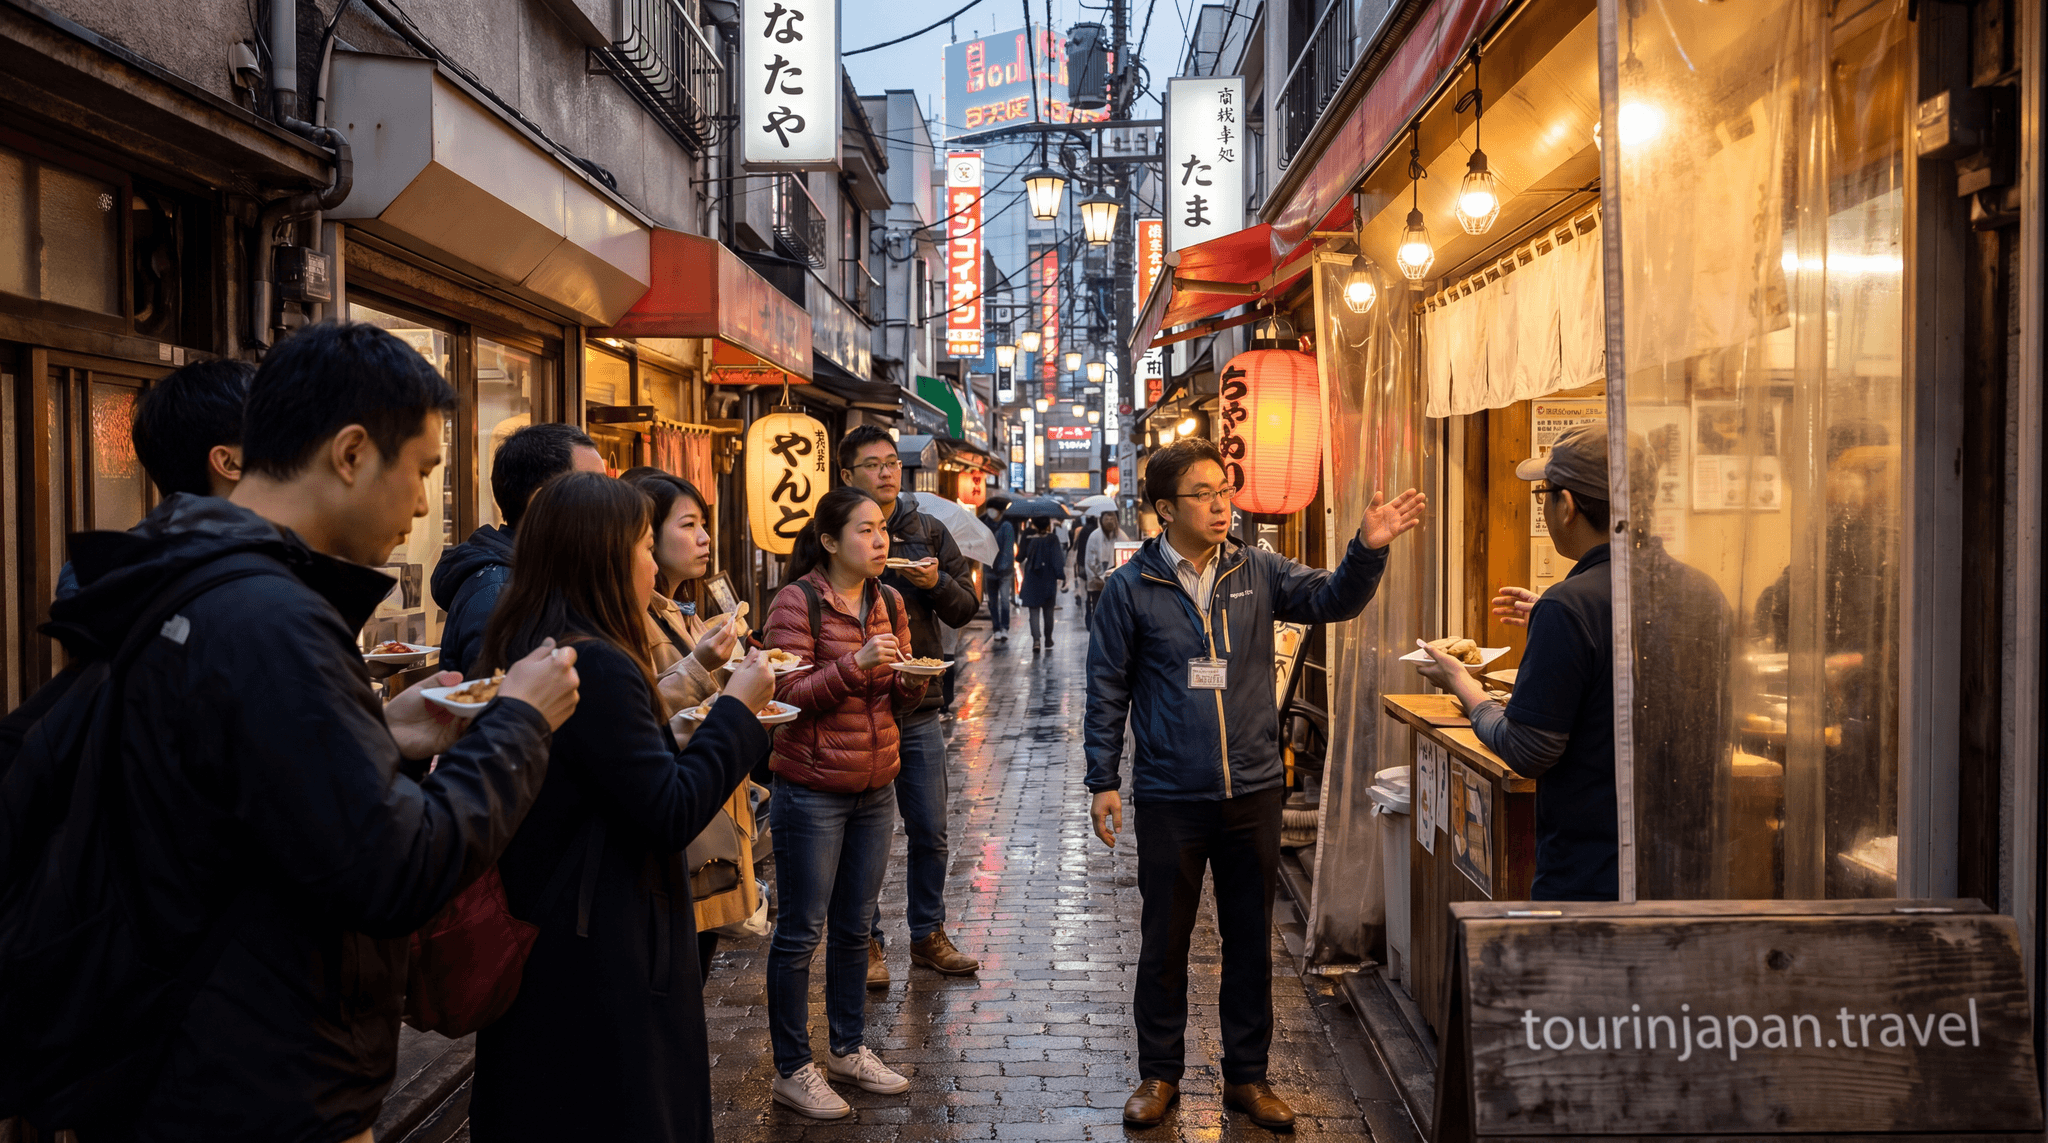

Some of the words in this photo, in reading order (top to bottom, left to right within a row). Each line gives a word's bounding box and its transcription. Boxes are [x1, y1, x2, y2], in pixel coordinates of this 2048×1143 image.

[762, 2, 806, 149] なたや
[1181, 154, 1213, 228] たま
[1521, 996, 1981, 1061] tourinjapan.travel
